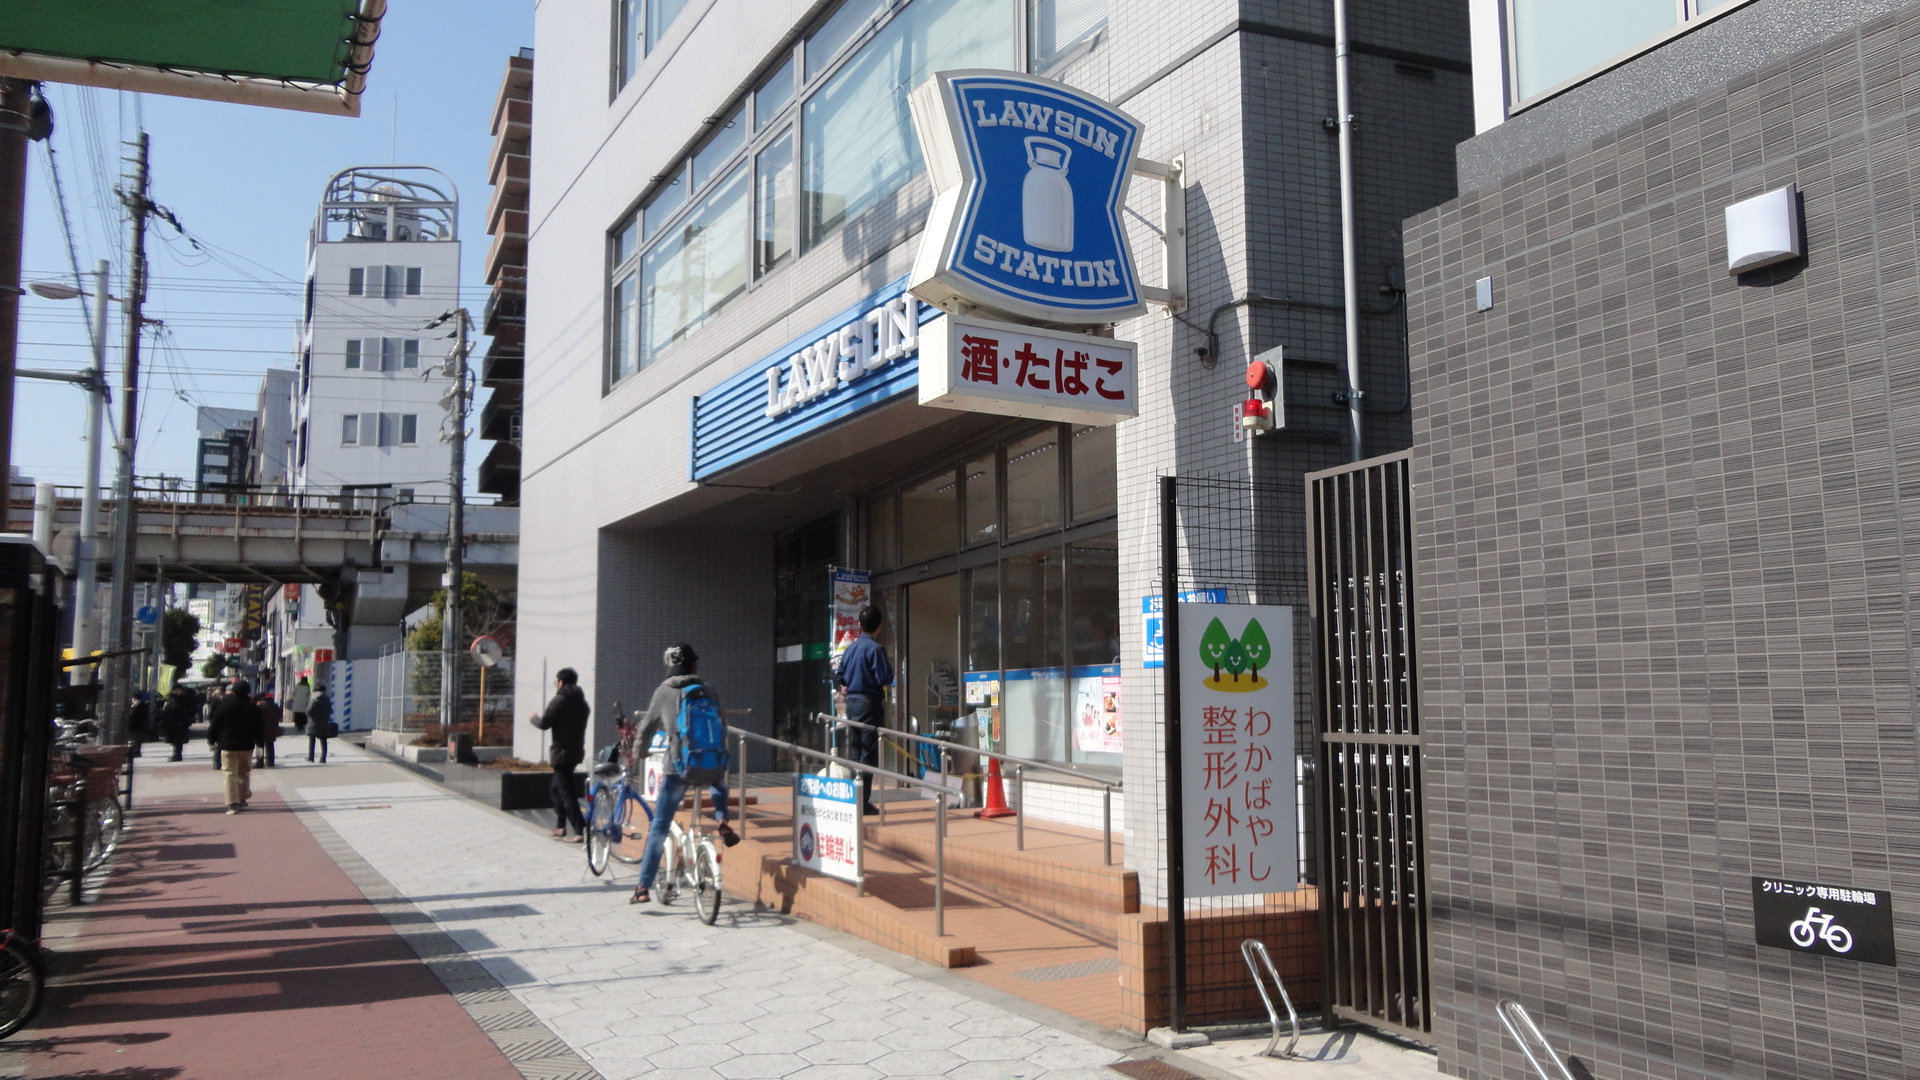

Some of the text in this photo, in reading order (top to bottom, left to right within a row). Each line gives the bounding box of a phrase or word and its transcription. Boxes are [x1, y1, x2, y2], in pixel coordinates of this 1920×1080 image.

[972, 99, 1119, 160] LAWSON
[973, 234, 1120, 288] STATION
[766, 292, 919, 418] LAWSON
[960, 333, 1125, 400] 酒・たばこ
[1202, 705, 1241, 886] 整形外科
[1244, 706, 1274, 882] わかばやし
[816, 831, 856, 866] 駐輪禁止
[1762, 880, 1877, 906] クリニック専用駐輪場
